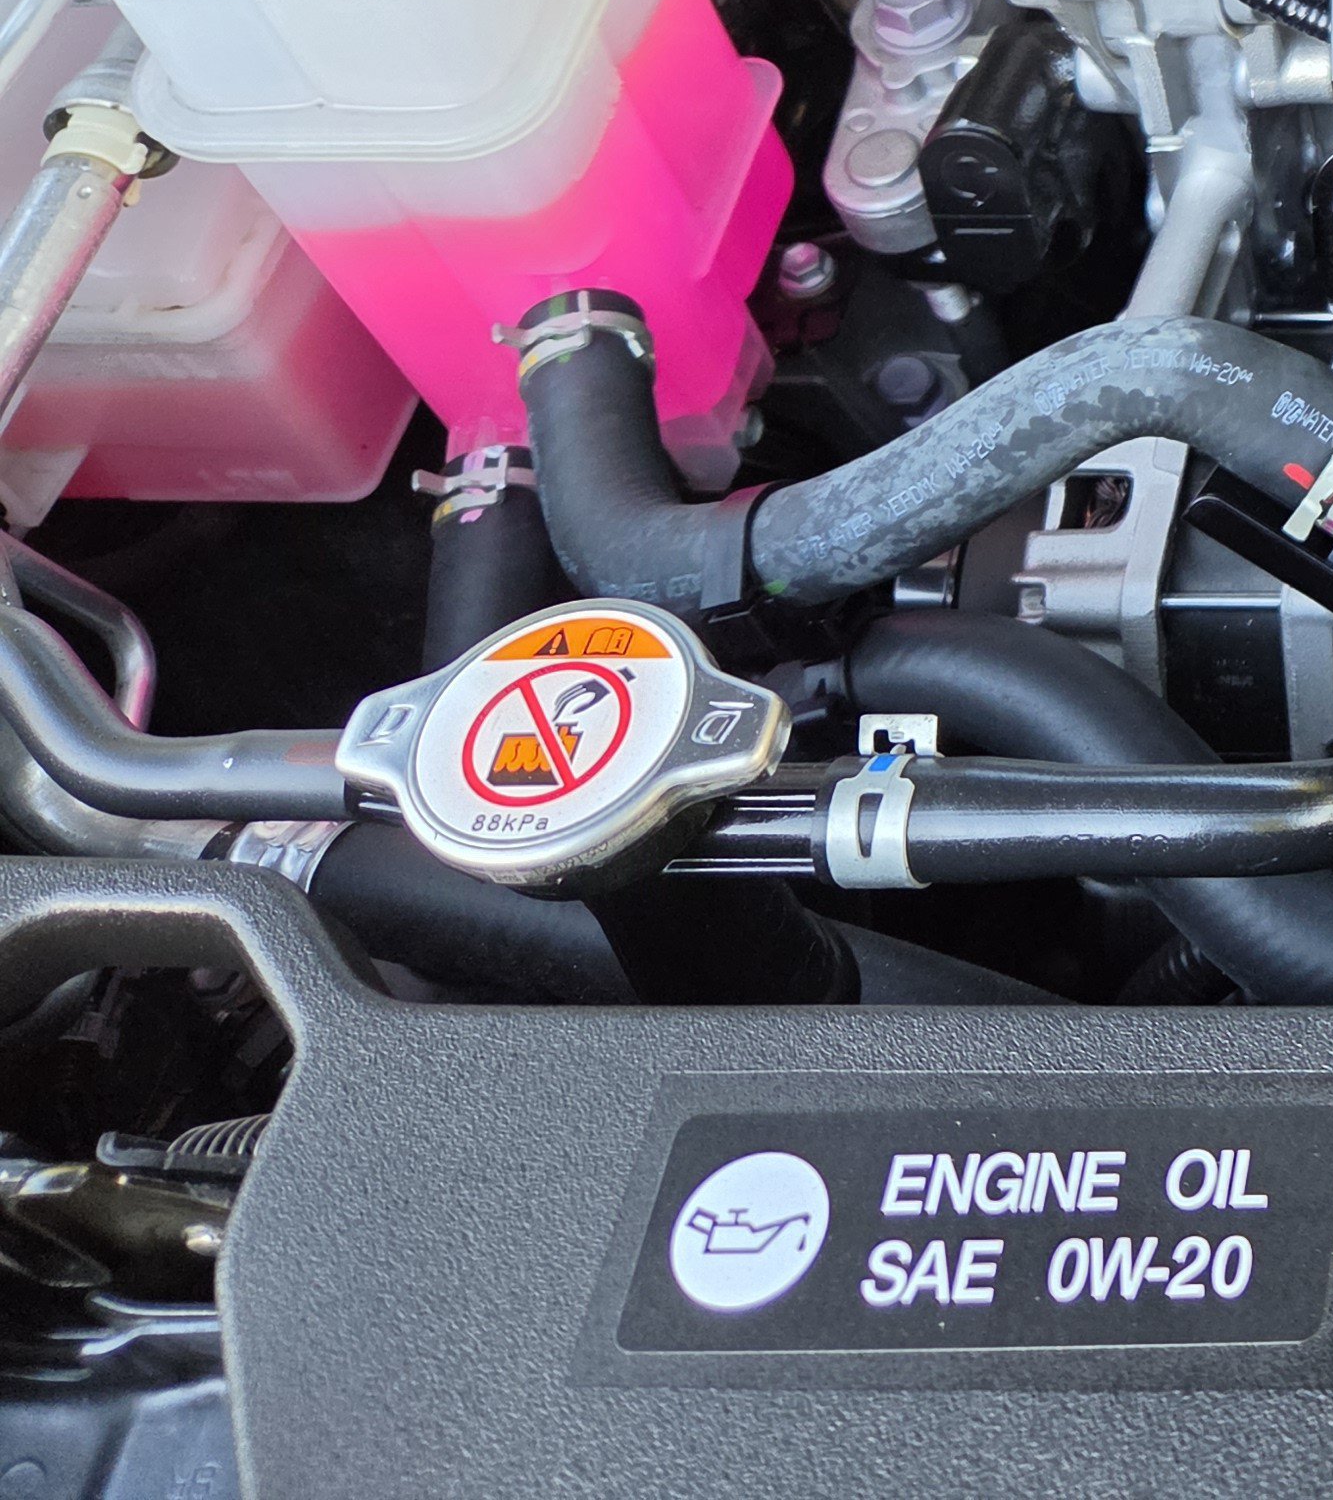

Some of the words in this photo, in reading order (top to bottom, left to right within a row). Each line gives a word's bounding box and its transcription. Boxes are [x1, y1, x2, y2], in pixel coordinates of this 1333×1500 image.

[471, 813, 550, 833] 88kPa
[880, 1150, 1127, 1216] ENGINE
[1165, 1148, 1269, 1212] OIL
[860, 1238, 1004, 1307] SAE
[1047, 1235, 1254, 1303] 0W-20
